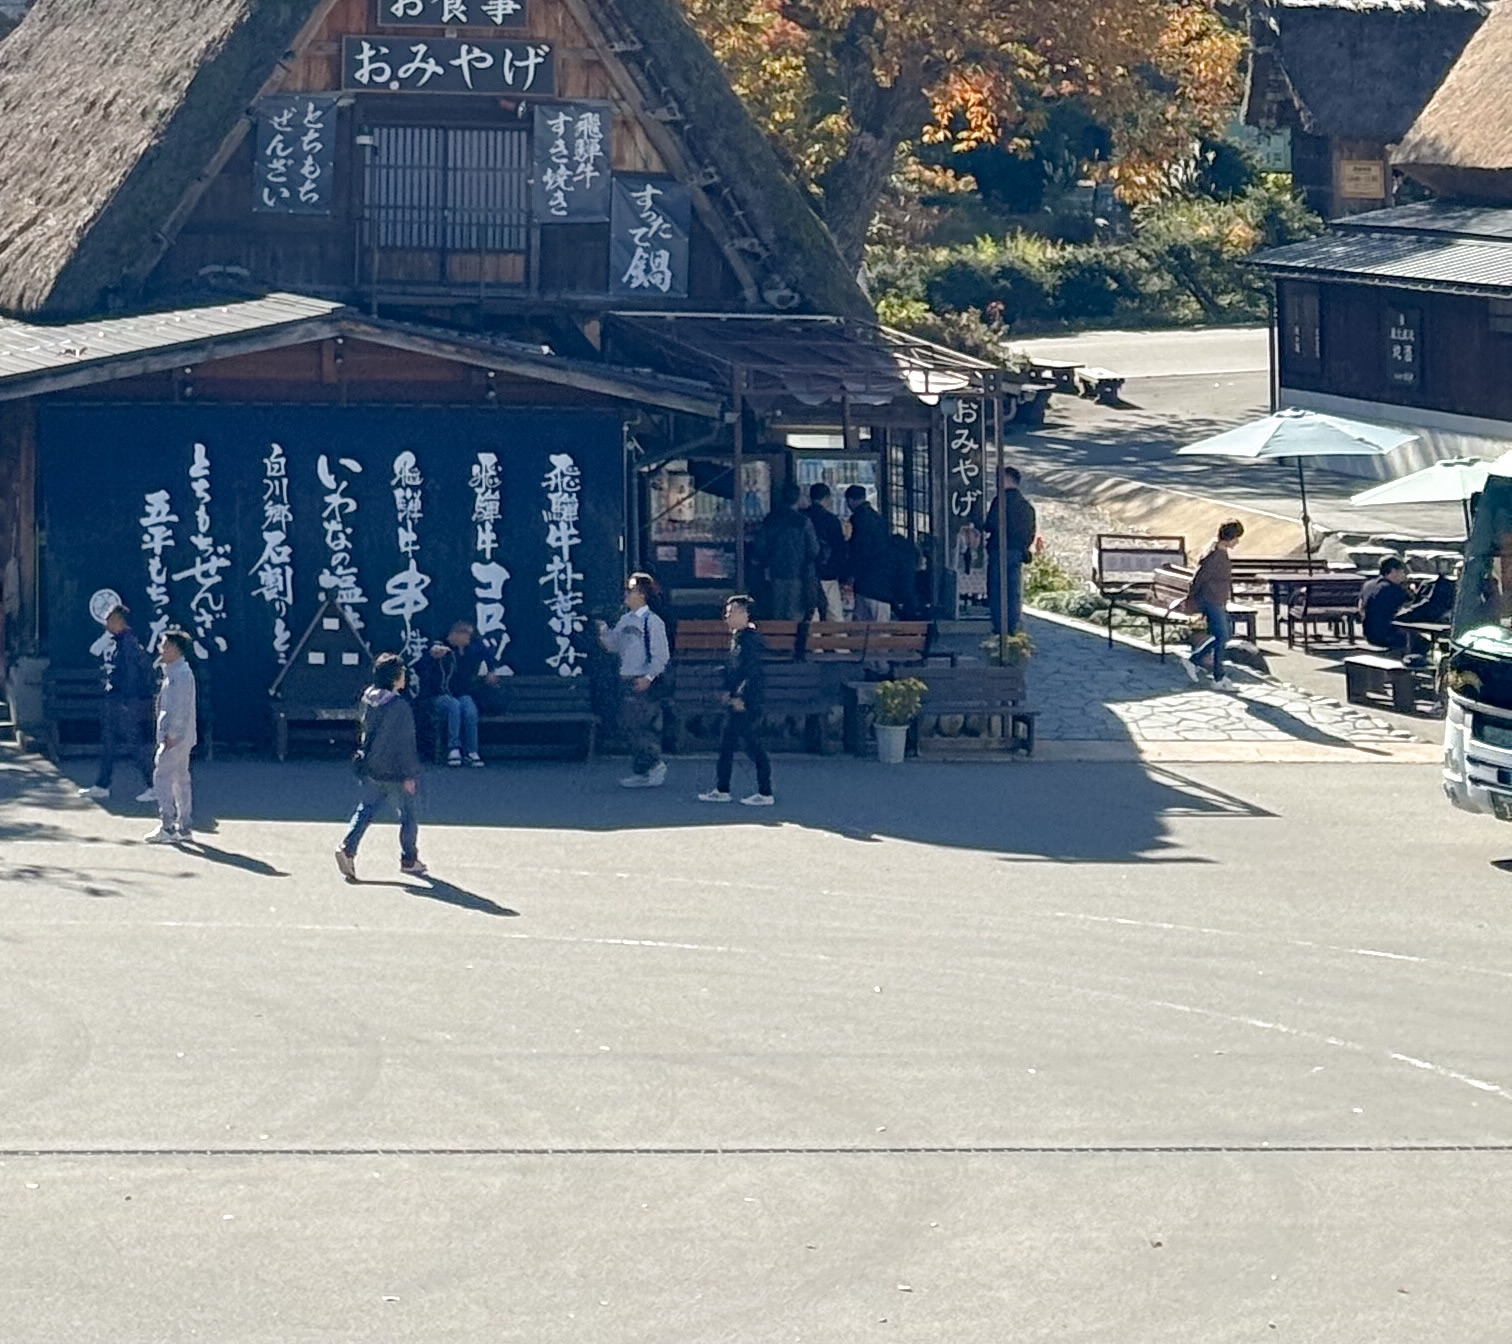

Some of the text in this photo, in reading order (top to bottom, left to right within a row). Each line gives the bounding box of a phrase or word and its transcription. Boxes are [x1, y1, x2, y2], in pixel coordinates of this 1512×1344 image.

[353, 39, 551, 91] おみやげ
[262, 106, 295, 208] ぜんざい
[298, 101, 325, 204] とちもち
[542, 111, 575, 216] すき焼き
[950, 398, 983, 518] おみやげ
